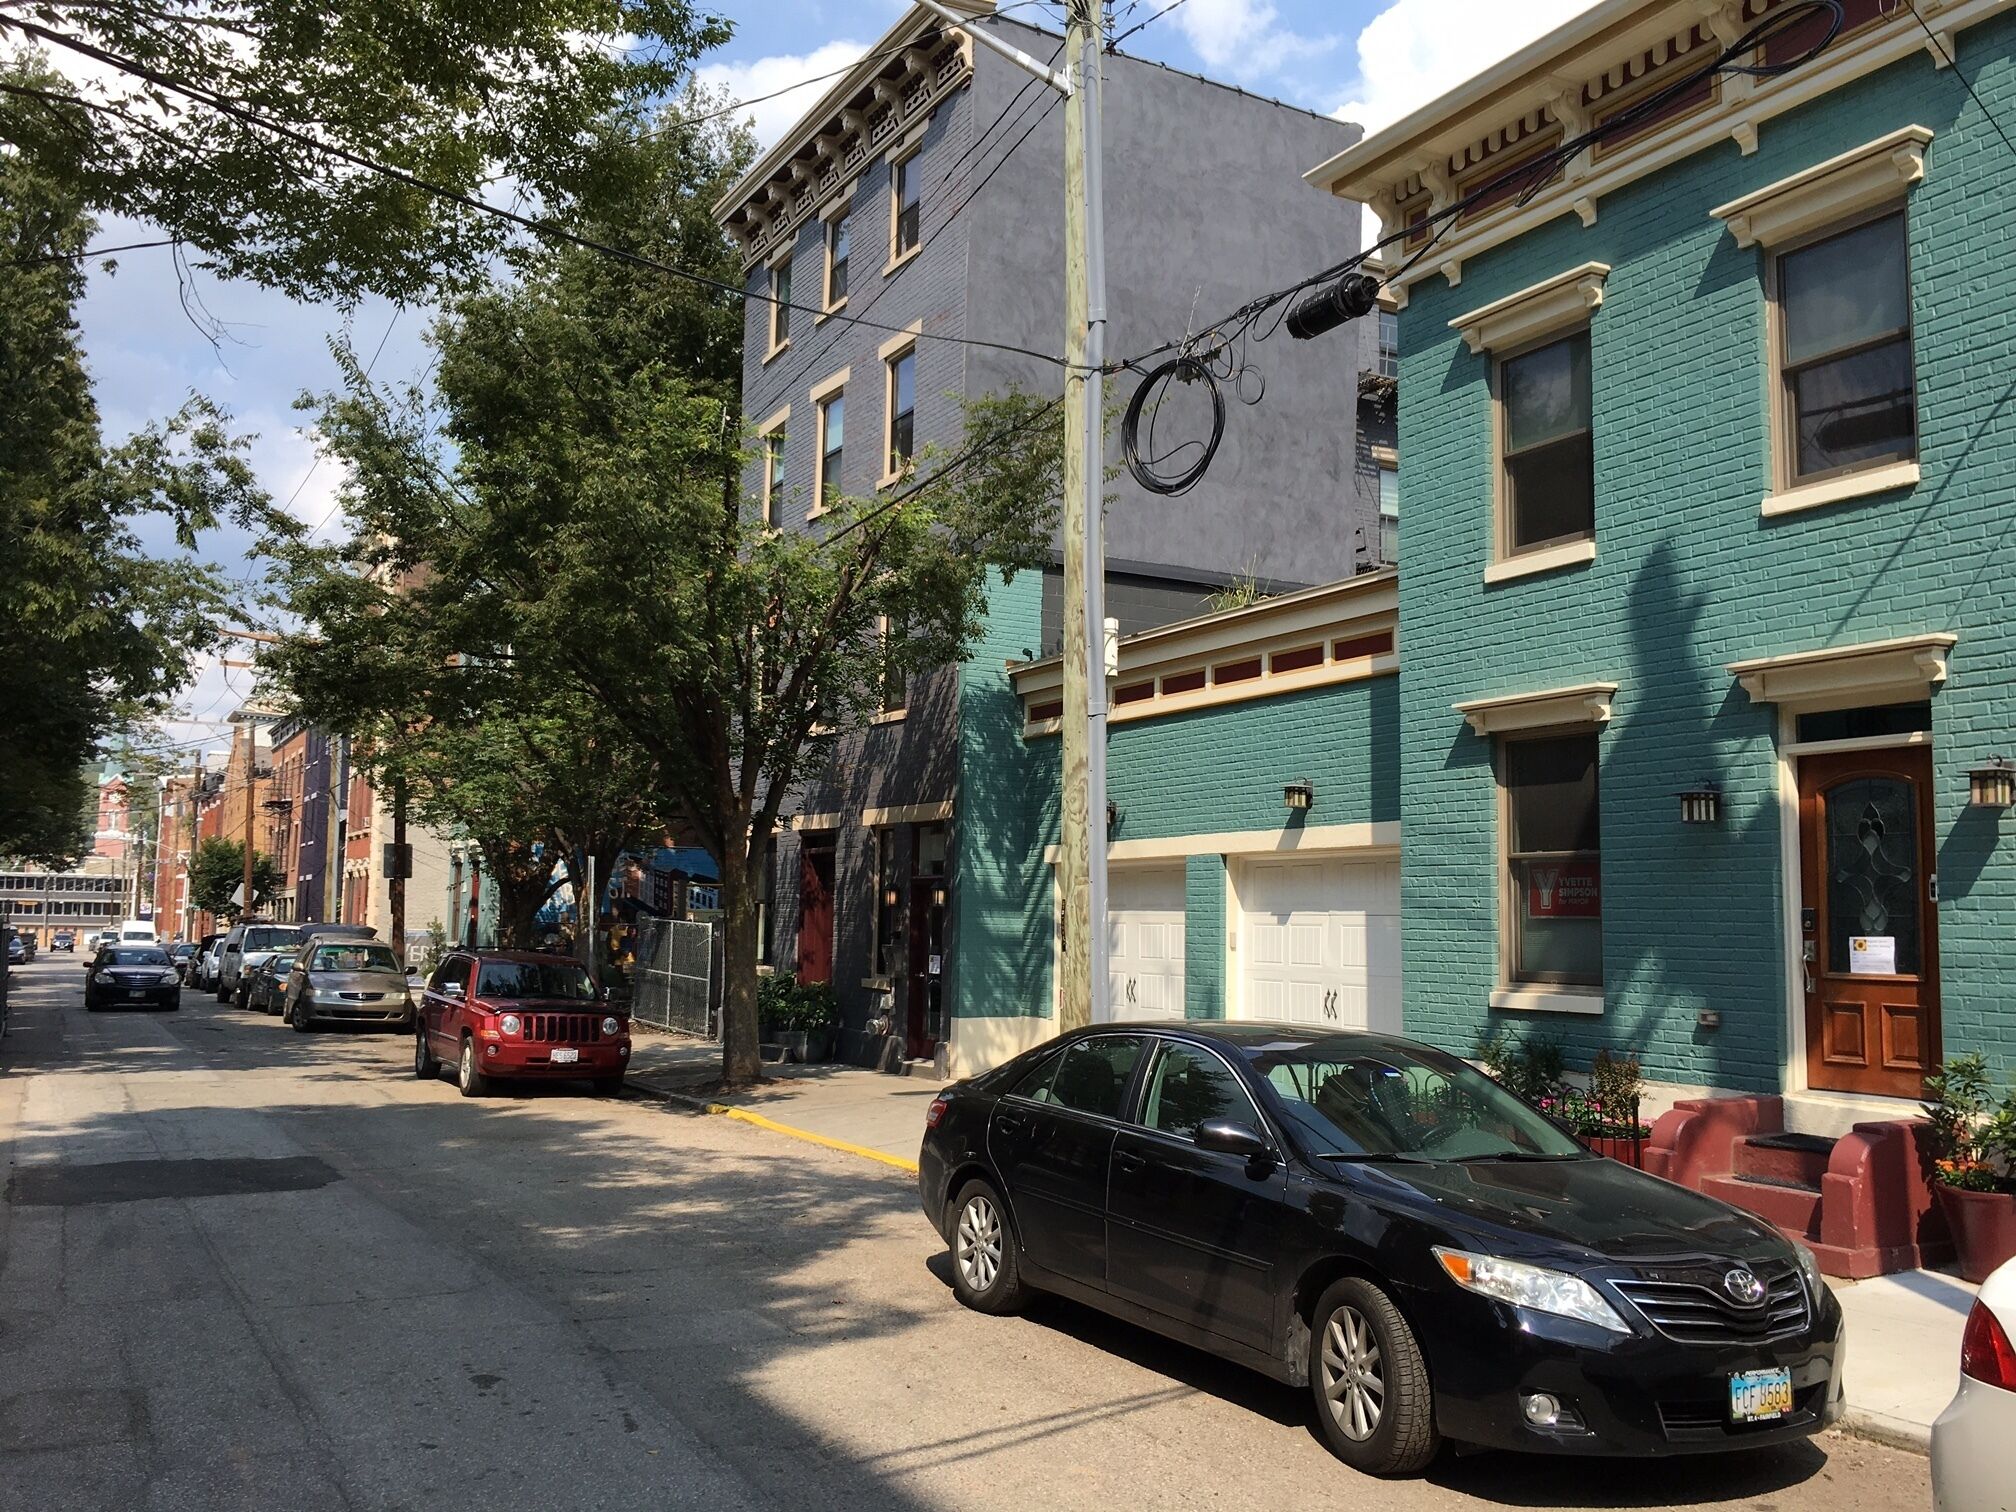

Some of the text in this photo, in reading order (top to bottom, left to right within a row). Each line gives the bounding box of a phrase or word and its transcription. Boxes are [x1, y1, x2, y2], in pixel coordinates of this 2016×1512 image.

[1559, 877, 1593, 886] YVETTE
[1559, 888, 1598, 896] SIMPSON
[1735, 1385, 1756, 1411] FCF
